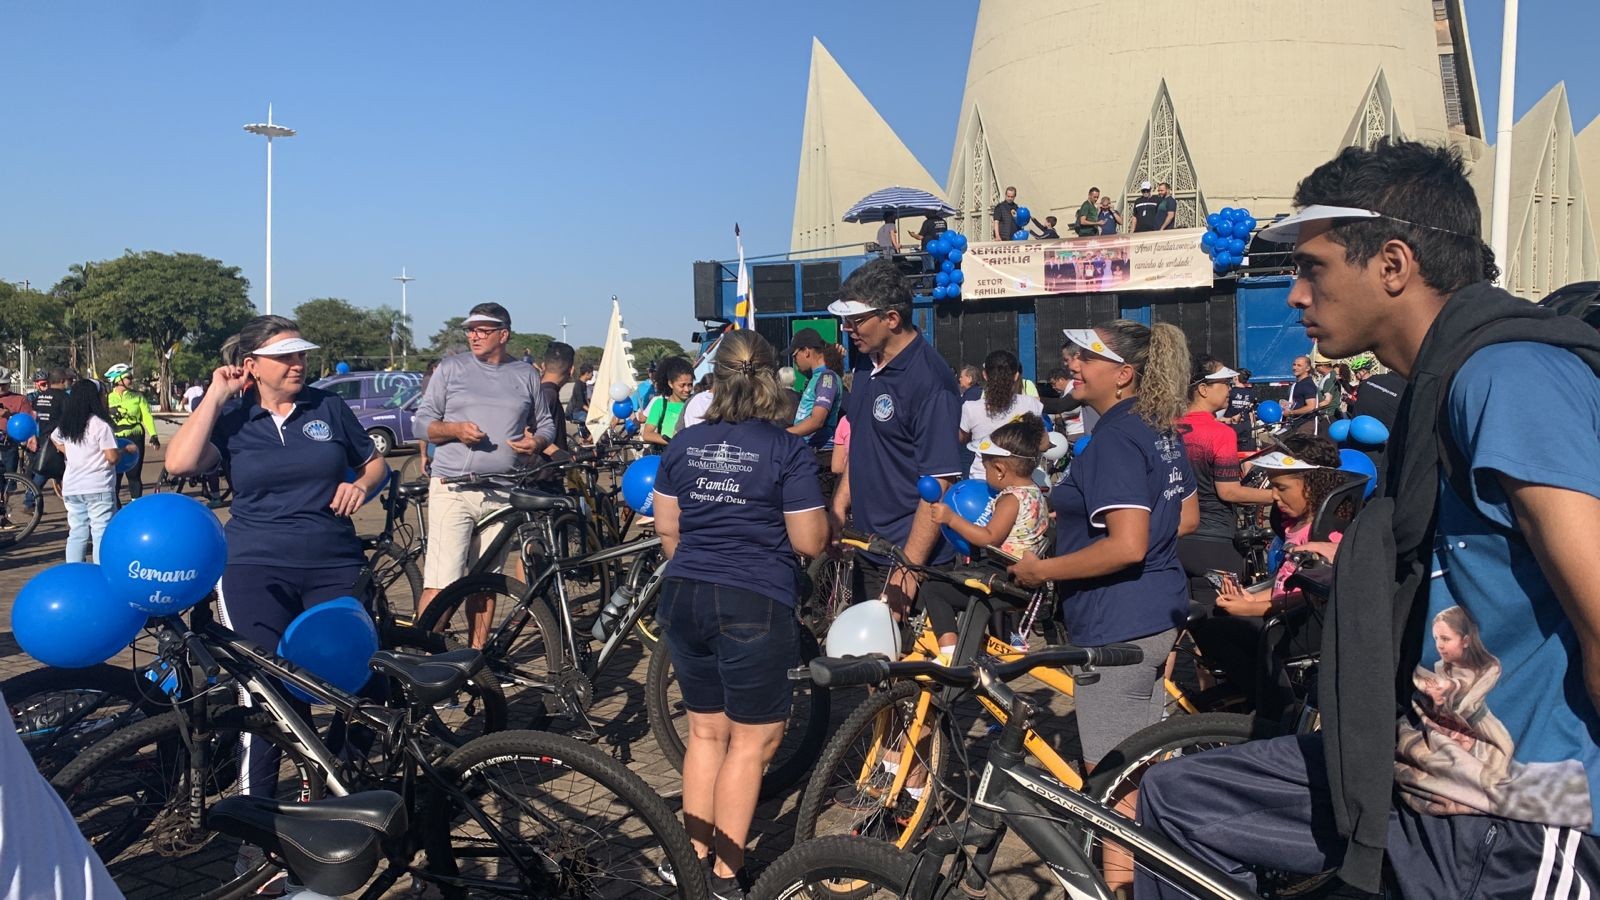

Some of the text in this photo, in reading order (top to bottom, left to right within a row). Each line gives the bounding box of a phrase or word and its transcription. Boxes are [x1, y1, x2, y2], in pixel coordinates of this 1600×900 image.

[971, 244, 1042, 255] SEMANA DA
[982, 255, 1031, 265] FAMÍLIA
[977, 278, 1003, 286] SETOR
[696, 477, 740, 493] Família
[689, 492, 746, 504] Projeto de Deus
[128, 560, 198, 583] Semana
[149, 590, 174, 604] da
[1027, 783, 1118, 832] ADVANCE new
